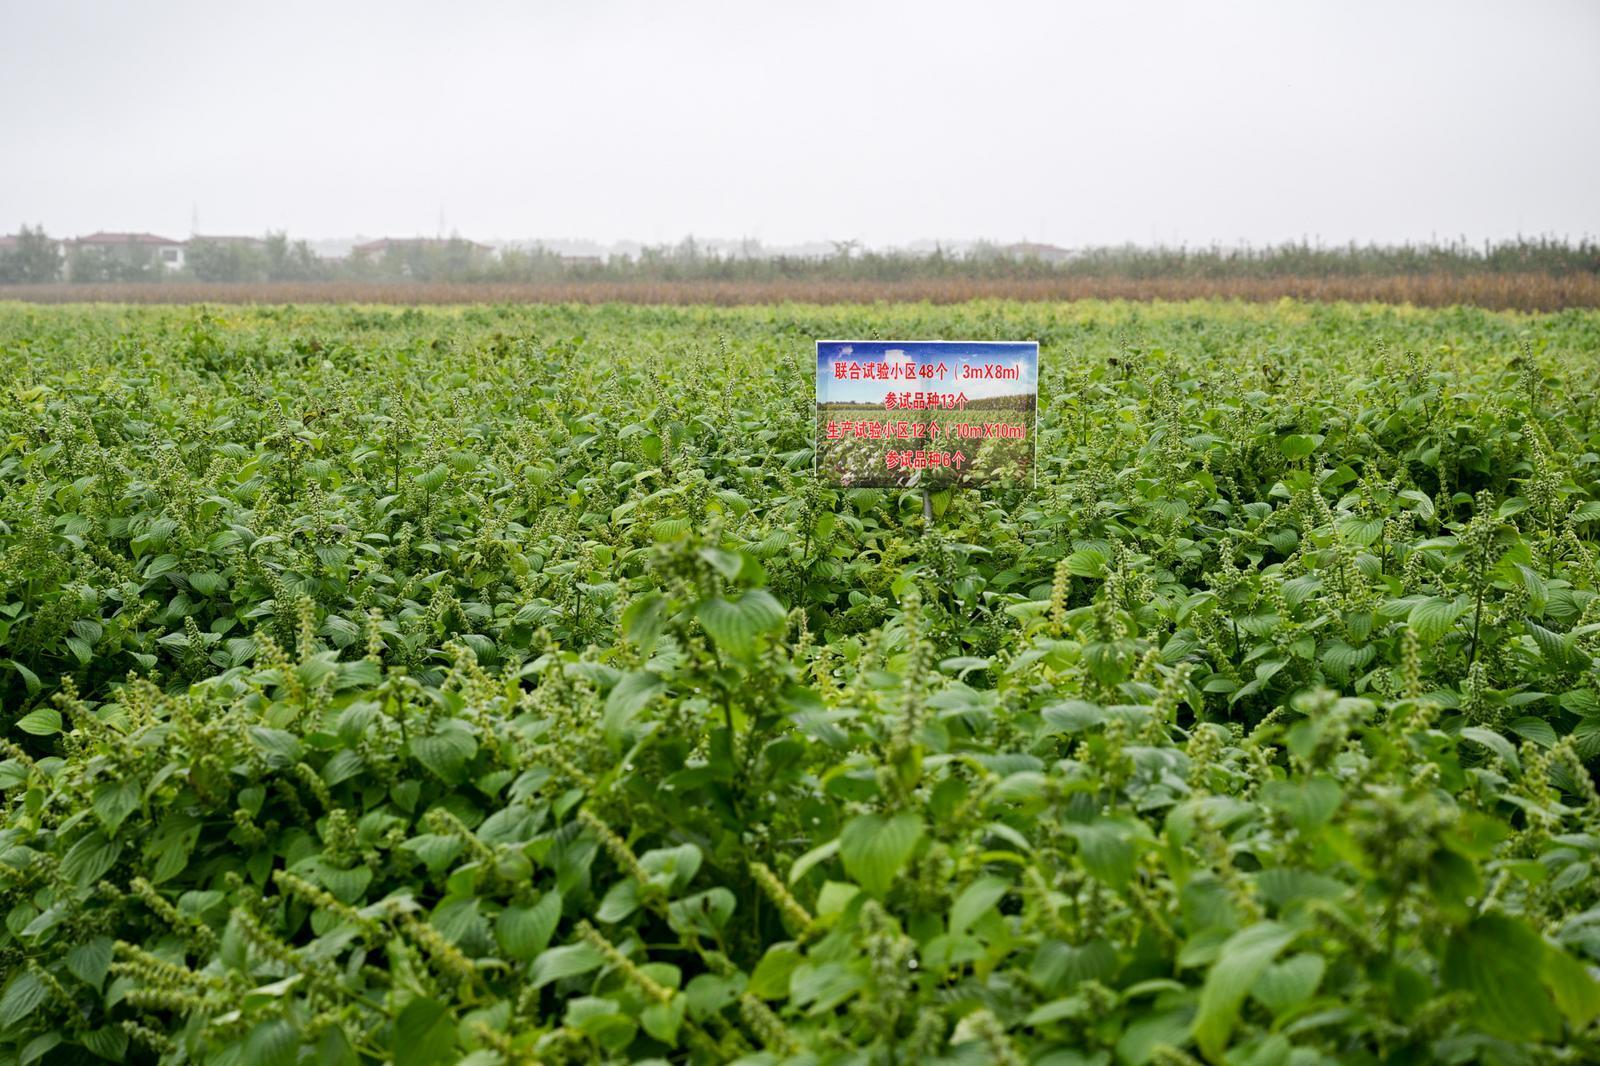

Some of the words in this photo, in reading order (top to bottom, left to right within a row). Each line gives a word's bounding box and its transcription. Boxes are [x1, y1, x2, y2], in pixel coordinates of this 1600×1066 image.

[884, 392, 968, 410] 参试品种13个
[885, 450, 966, 469] 参试品种6个
